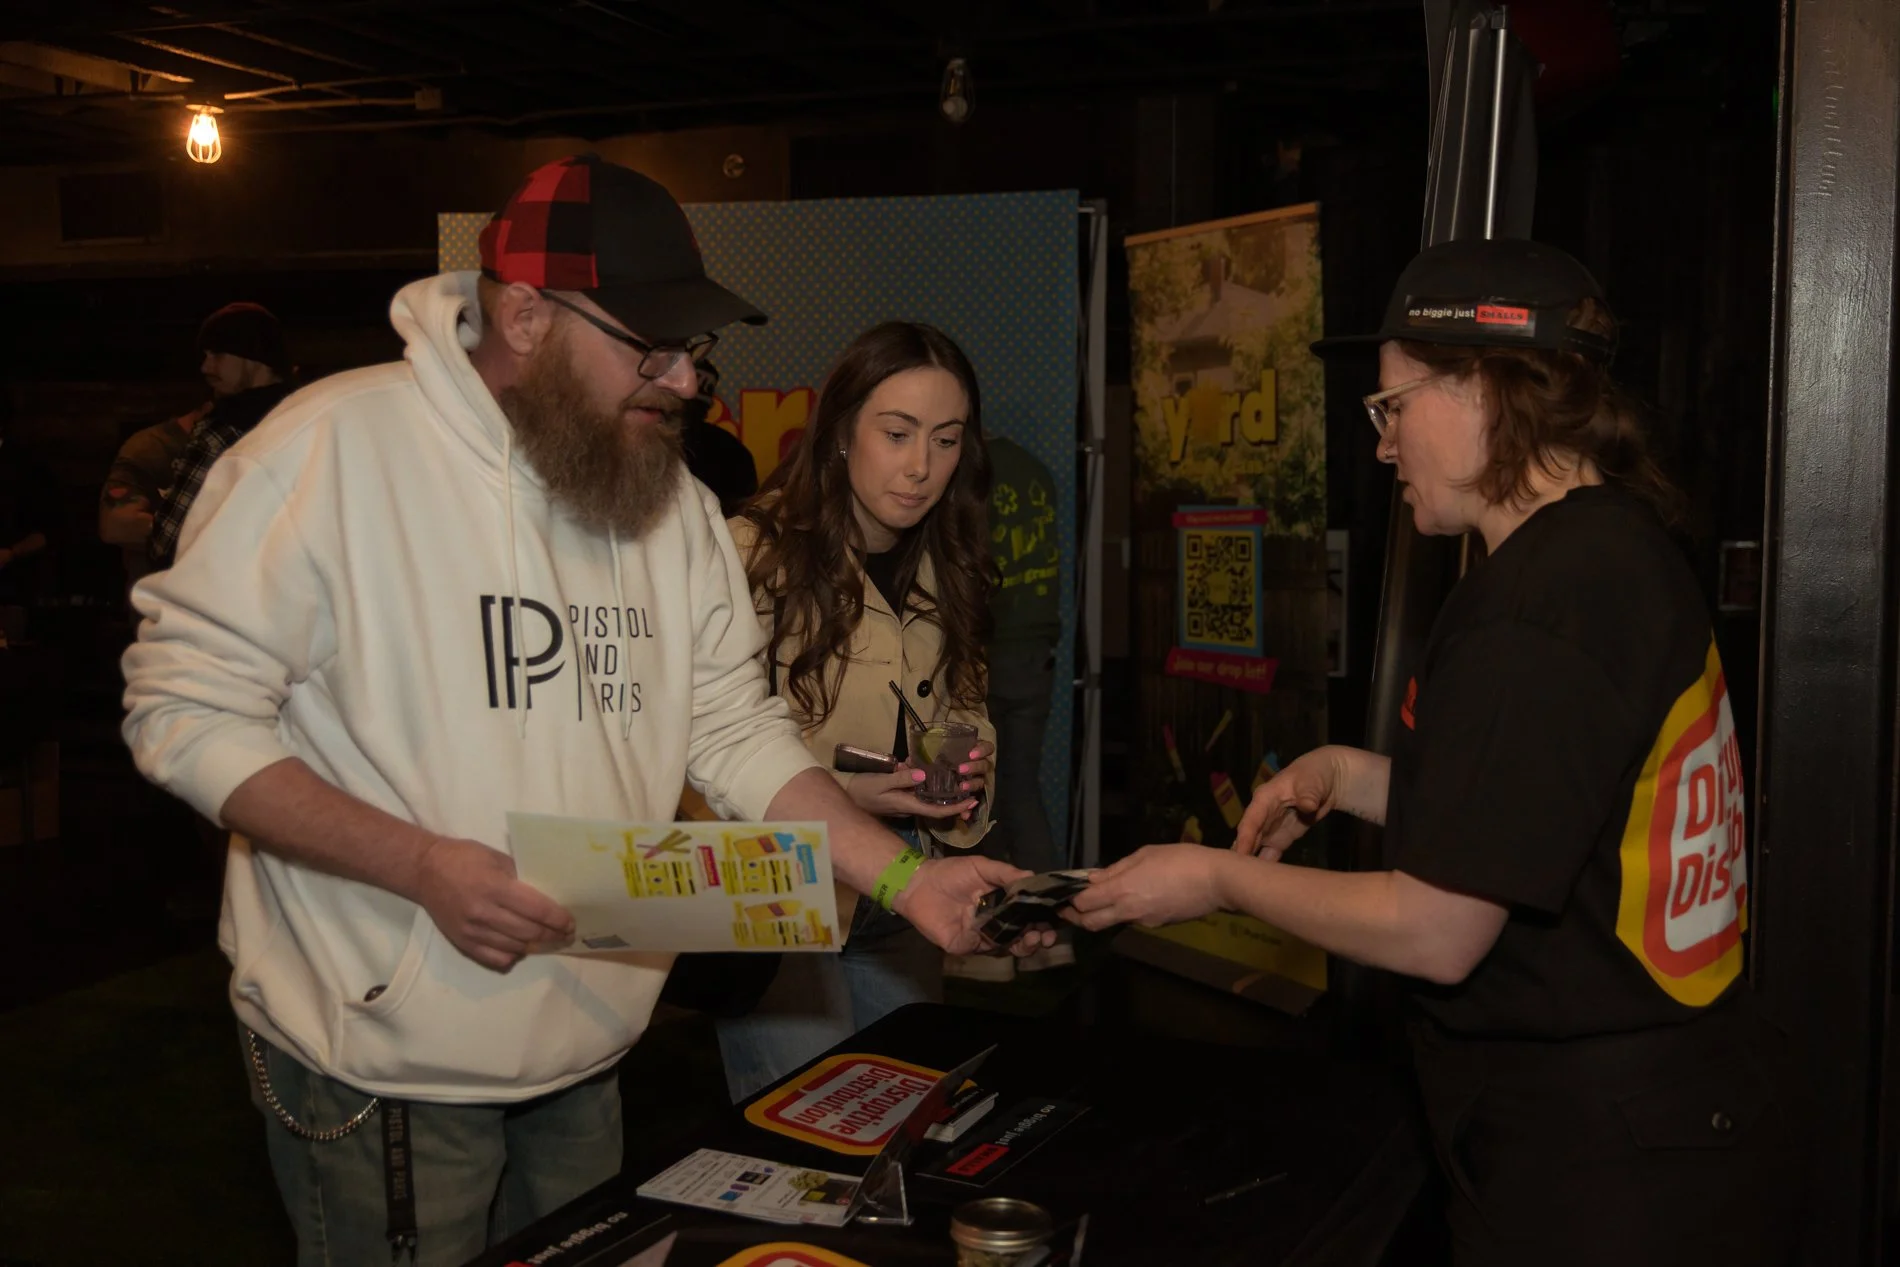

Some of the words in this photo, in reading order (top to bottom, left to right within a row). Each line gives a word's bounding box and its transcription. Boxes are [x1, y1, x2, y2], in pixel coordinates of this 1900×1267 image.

[1408, 308, 1421, 317] no
[1422, 308, 1453, 319] biggie
[1454, 308, 1476, 319] just
[1161, 367, 1278, 465] yrd
[568, 604, 654, 639] PISTOL
[584, 643, 618, 676] ND
[592, 682, 642, 714] RIS
[794, 1067, 898, 1124] Distribution
[829, 1077, 931, 1136] Disruptive
